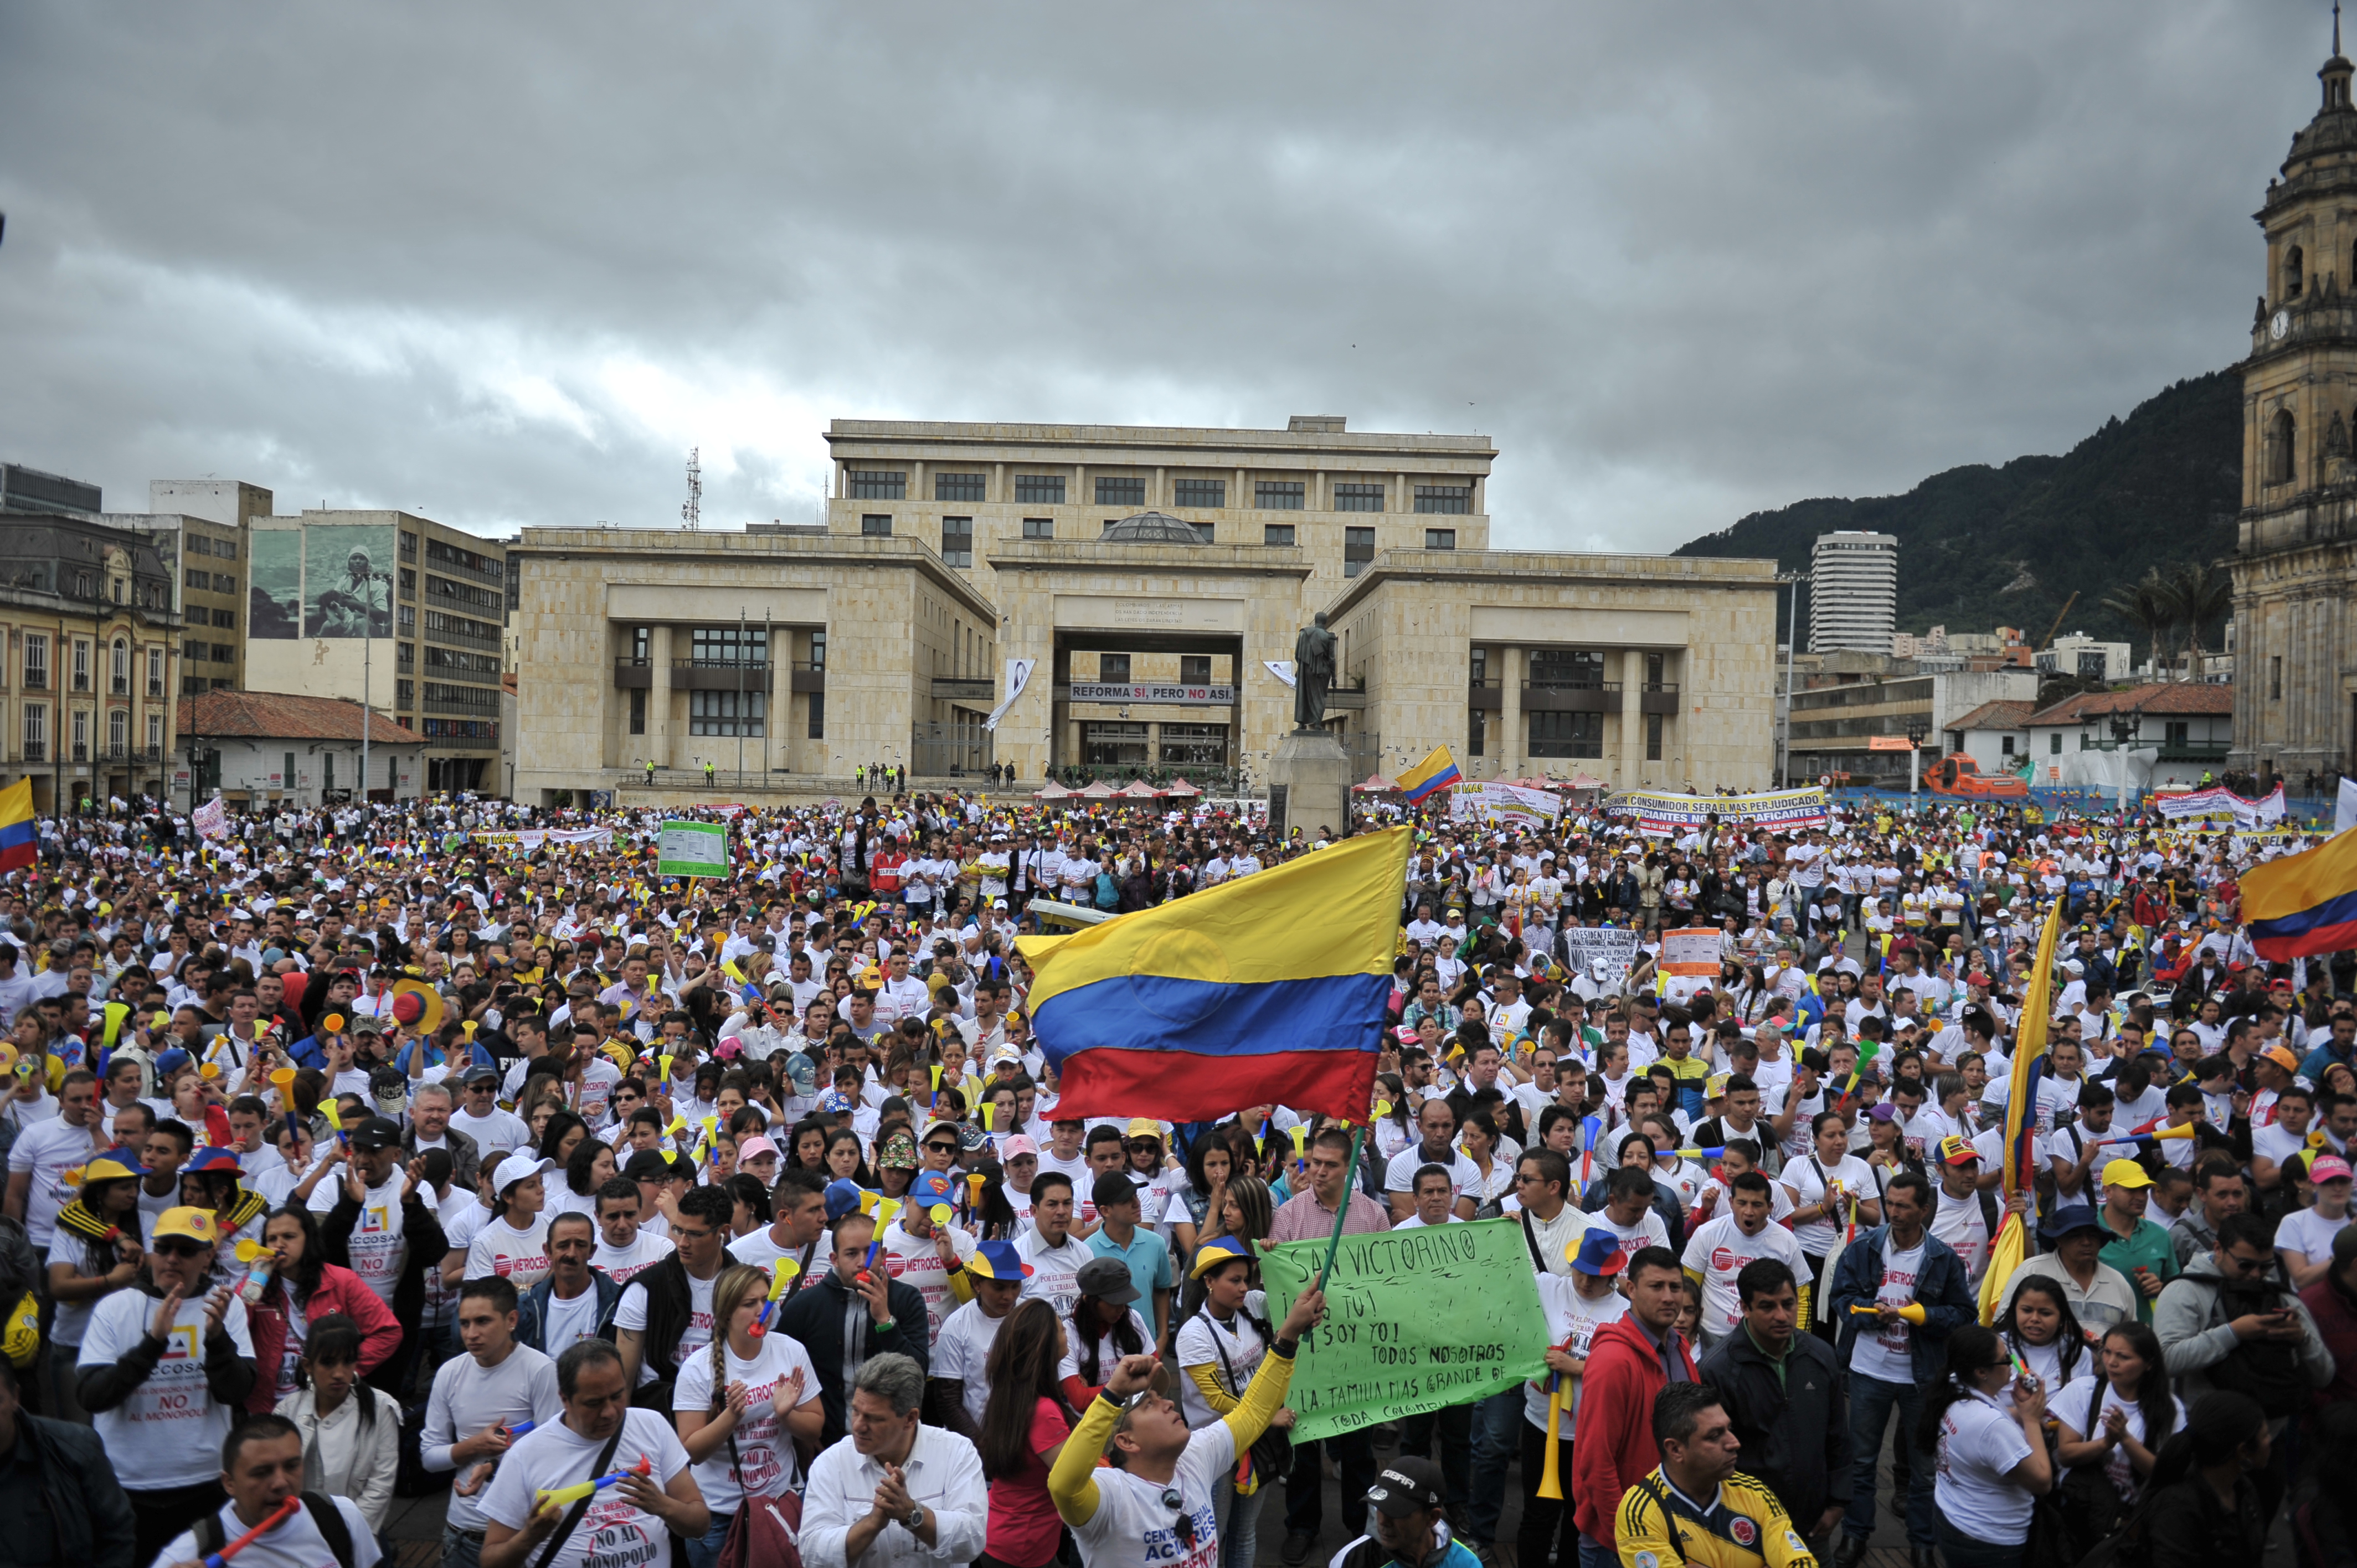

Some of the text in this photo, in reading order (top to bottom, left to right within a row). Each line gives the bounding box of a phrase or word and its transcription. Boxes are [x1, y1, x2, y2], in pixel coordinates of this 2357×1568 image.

[1073, 684, 1233, 700] REFORMA SÍ, PERO NO ASÍ.
[1453, 785, 1461, 794] NO
[1463, 783, 1484, 793] MAS
[1630, 796, 1689, 812] CONSUMIDOR
[1692, 803, 1717, 812] SERA
[1719, 803, 1727, 812] EL
[1729, 803, 1747, 812] MAS
[1750, 795, 1819, 812] PERJUDICADO
[1609, 807, 1688, 823] COMERCIANTES
[1718, 807, 1820, 824] ARCOTRAFICANTES
[476, 835, 489, 844] NO
[492, 833, 517, 844] MAS
[2098, 829, 2140, 842] SOOS
[1571, 949, 1584, 971] NO
[347, 1233, 403, 1245] ACCOSAN
[361, 1258, 383, 1270] NO
[1291, 1230, 1476, 1283] SAN VICTORINO
[1059, 1272, 1077, 1281] DERECH
[920, 1284, 948, 1293] DERECHO
[1056, 1281, 1077, 1290] TRABAJO
[924, 1294, 941, 1303] ABAJO
[1053, 1296, 1075, 1311] NO AL
[1563, 1311, 1575, 1321] POR
[1583, 1317, 1599, 1327] DERE
[1369, 1323, 1399, 1343] YO!
[1576, 1324, 1594, 1333] TRABA
[1243, 1340, 1263, 1358] DERECHO
[1877, 1335, 1910, 1353] MONOPO
[1372, 1344, 1505, 1365] TODOS NOSOTROS
[150, 1361, 206, 1375] CCOSA
[1234, 1371, 1247, 1385] NO
[1389, 1377, 1419, 1401] MAS
[1427, 1366, 1484, 1393] GRANDE
[158, 1395, 188, 1410] NO
[129, 1412, 142, 1422] AL
[758, 1417, 780, 1427] DEREC
[1331, 1412, 1373, 1430] TODA
[738, 1428, 779, 1441] AL TRABAJO
[747, 1450, 775, 1466] NO AL
[591, 1500, 627, 1514] EL DERE
[585, 1507, 636, 1528] AL TRABAJO
[594, 1524, 639, 1549] NO AL
[580, 1542, 657, 1568] MONOPOLIO
